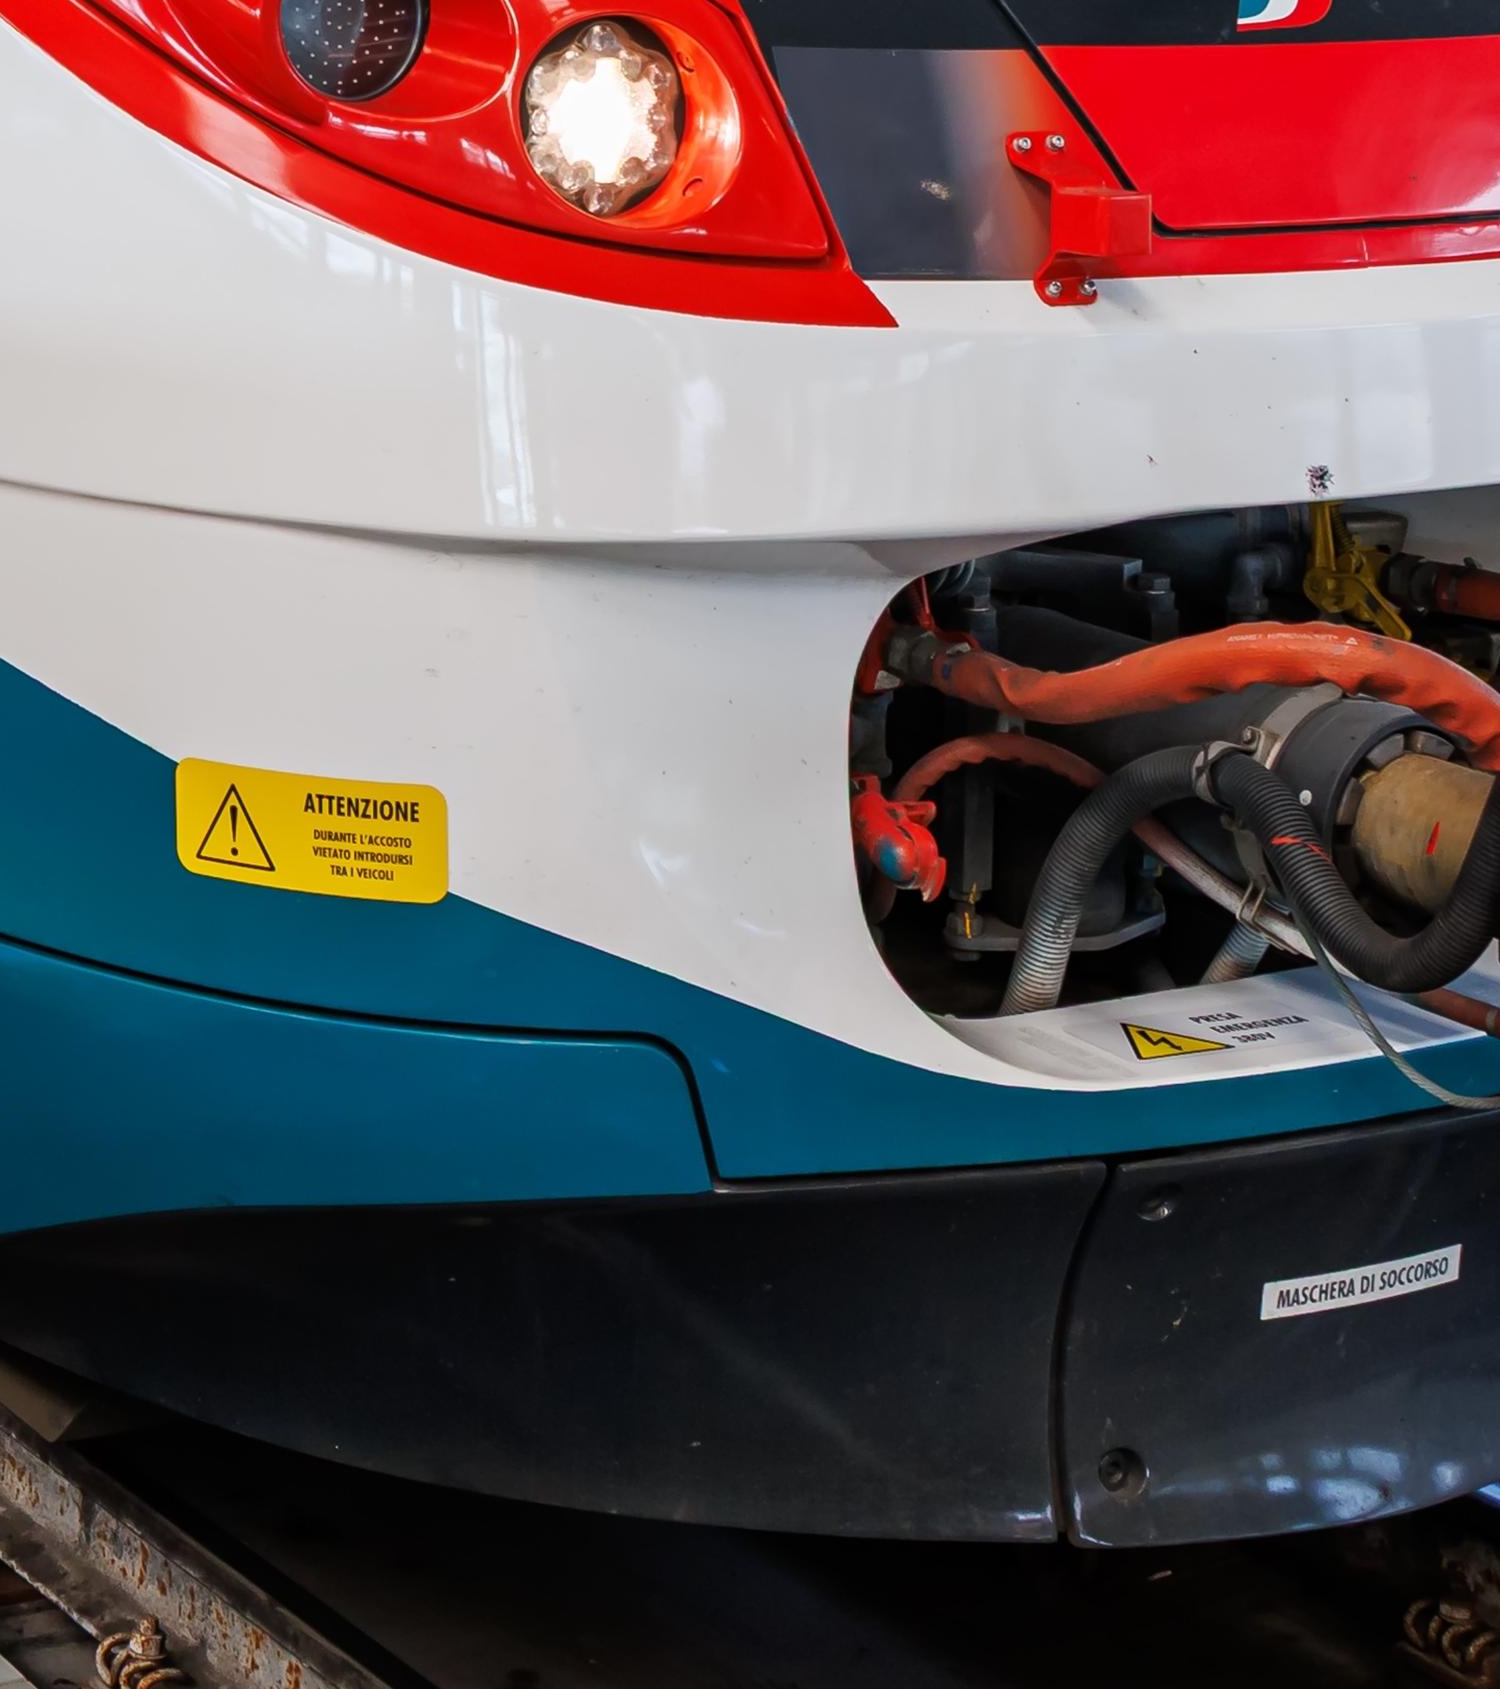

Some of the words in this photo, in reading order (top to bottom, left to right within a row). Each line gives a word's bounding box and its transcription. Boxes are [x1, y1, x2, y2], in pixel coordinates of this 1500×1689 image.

[303, 792, 420, 823] ATTENZIONE
[313, 829, 357, 844] DURANTE
[360, 834, 412, 849] L'ACCOSTO
[312, 846, 351, 860] VIETATO
[353, 850, 413, 865] INTRODURSI
[330, 865, 348, 877] TRA
[350, 867, 354, 877] I
[356, 867, 394, 881] VEICOLI
[1189, 1012, 1243, 1024] PRESA
[1209, 1015, 1309, 1034] EMERGENZA
[1276, 1278, 1355, 1309] MASCHERA
[1359, 1273, 1375, 1295] DI
[1378, 1256, 1449, 1291] SOCCORSO
